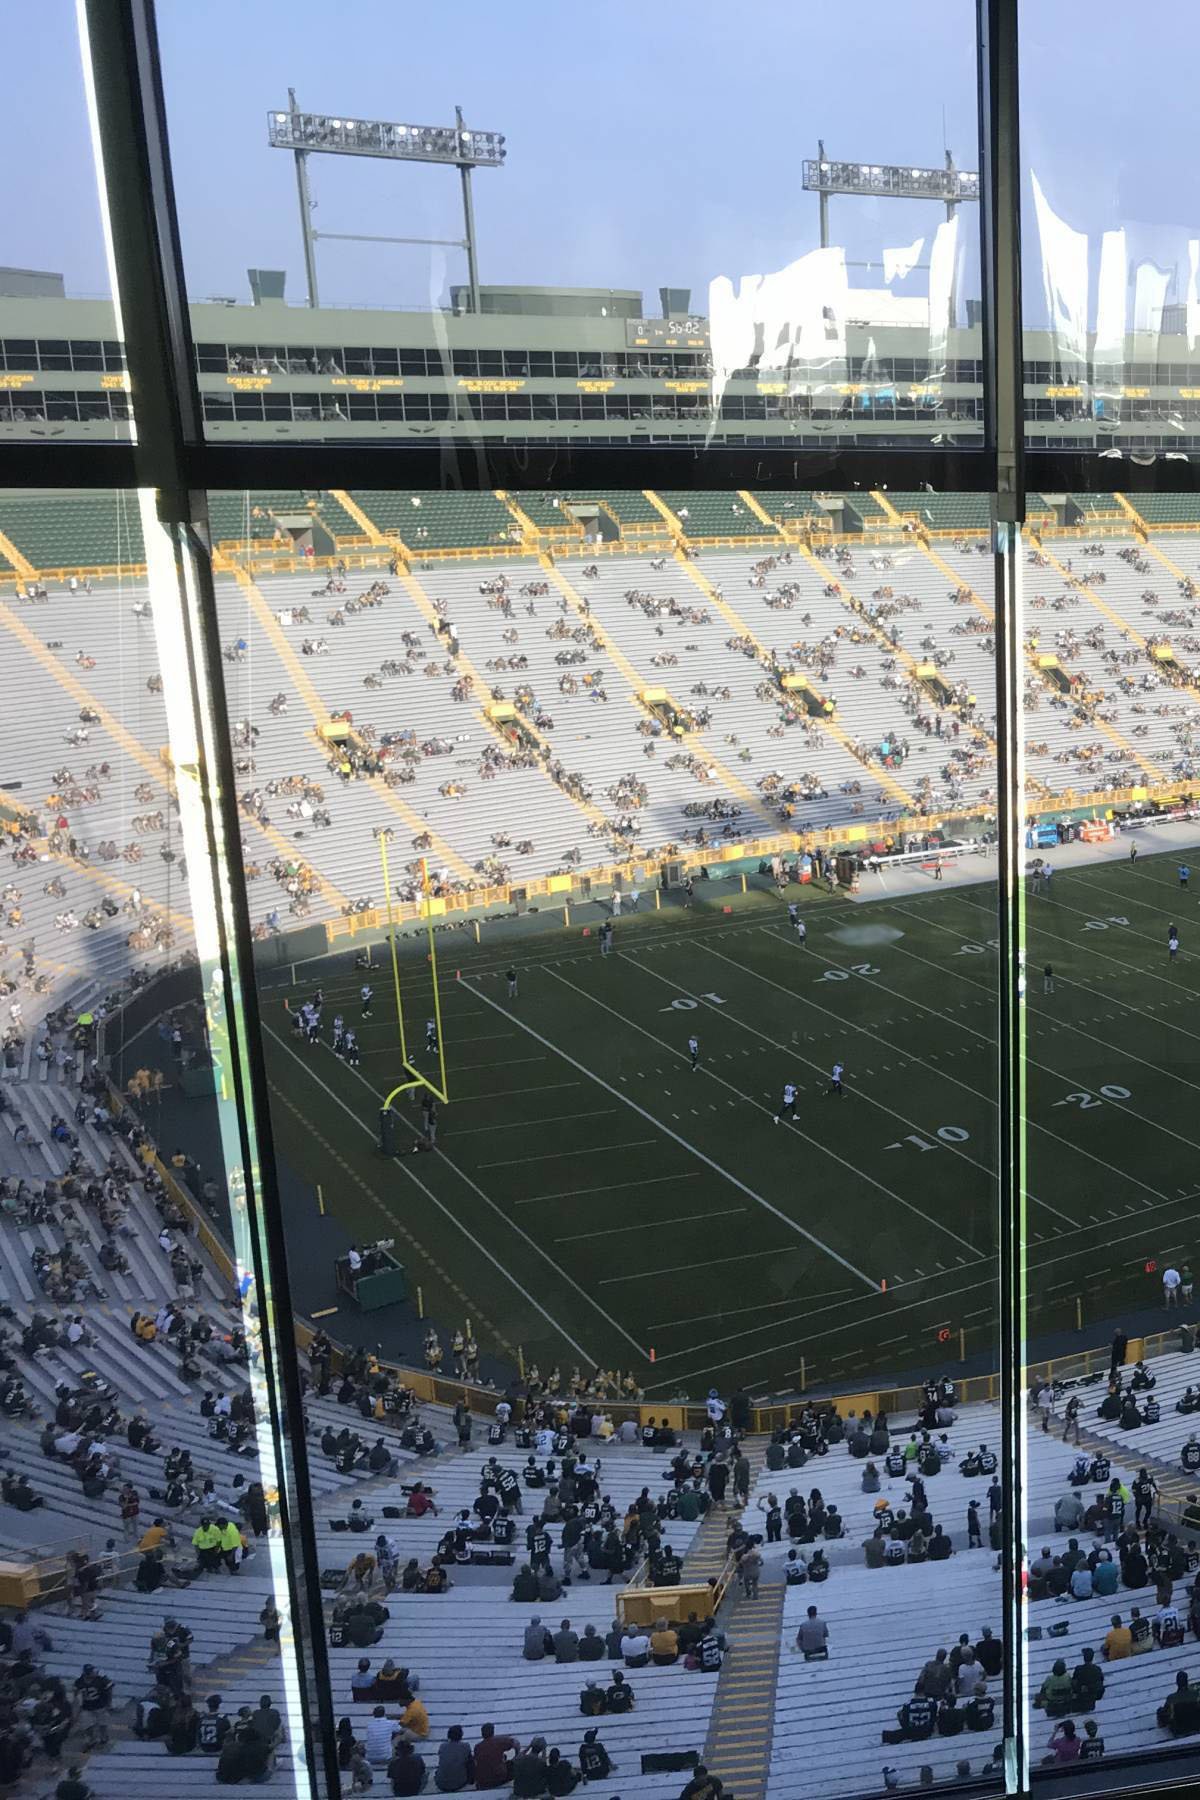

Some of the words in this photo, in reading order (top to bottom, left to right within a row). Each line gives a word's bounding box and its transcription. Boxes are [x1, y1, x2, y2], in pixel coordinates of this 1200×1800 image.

[1085, 916, 1130, 930] 40
[823, 963, 880, 981] 20
[671, 992, 728, 1010] 10
[1065, 1084, 1132, 1109] 20
[903, 1126, 970, 1152] 10
[945, 1385, 953, 1394] 12
[559, 1440, 567, 1449] 17
[1187, 1452, 1199, 1462] 88
[503, 1476, 516, 1491] 52
[1112, 1501, 1122, 1514] 12
[881, 1517, 891, 1528] 12
[534, 1540, 546, 1553] 12
[1165, 1616, 1178, 1630] 21
[332, 1632, 342, 1642] 12
[200, 1726, 216, 1743] 12
[587, 1754, 600, 1770] 12
